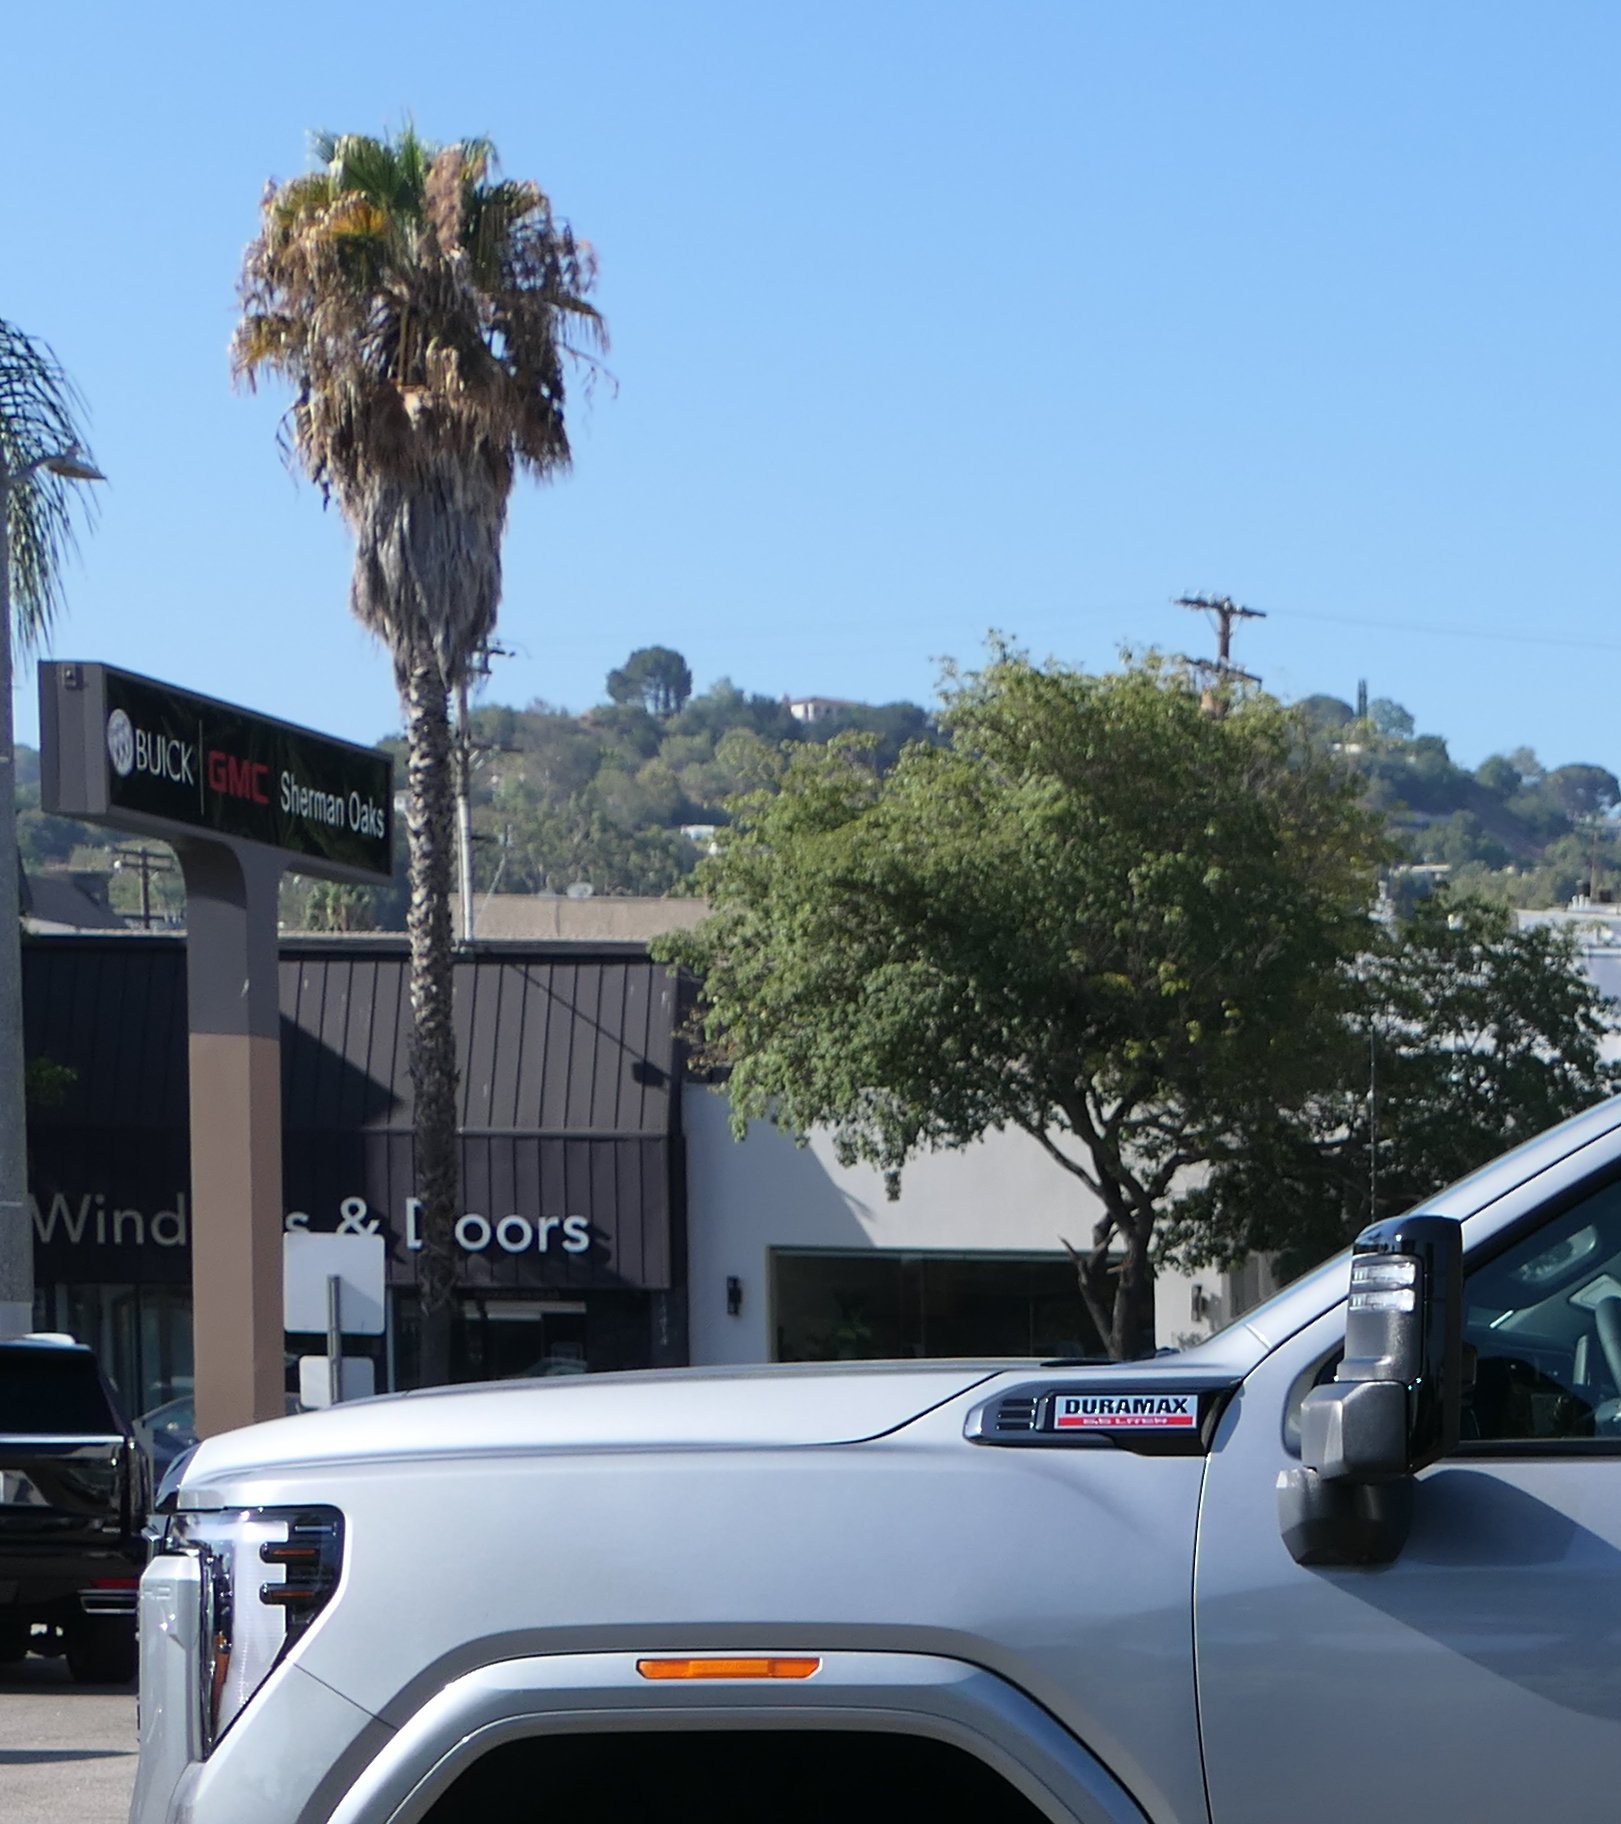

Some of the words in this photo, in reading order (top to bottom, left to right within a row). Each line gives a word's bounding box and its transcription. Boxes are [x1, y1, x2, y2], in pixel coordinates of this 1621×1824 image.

[135, 728, 194, 787] BUICK
[207, 750, 270, 805] GMC
[281, 770, 345, 828] Sherman
[350, 790, 385, 840] Oaks
[1065, 1399, 1188, 1414] DURAMAX
